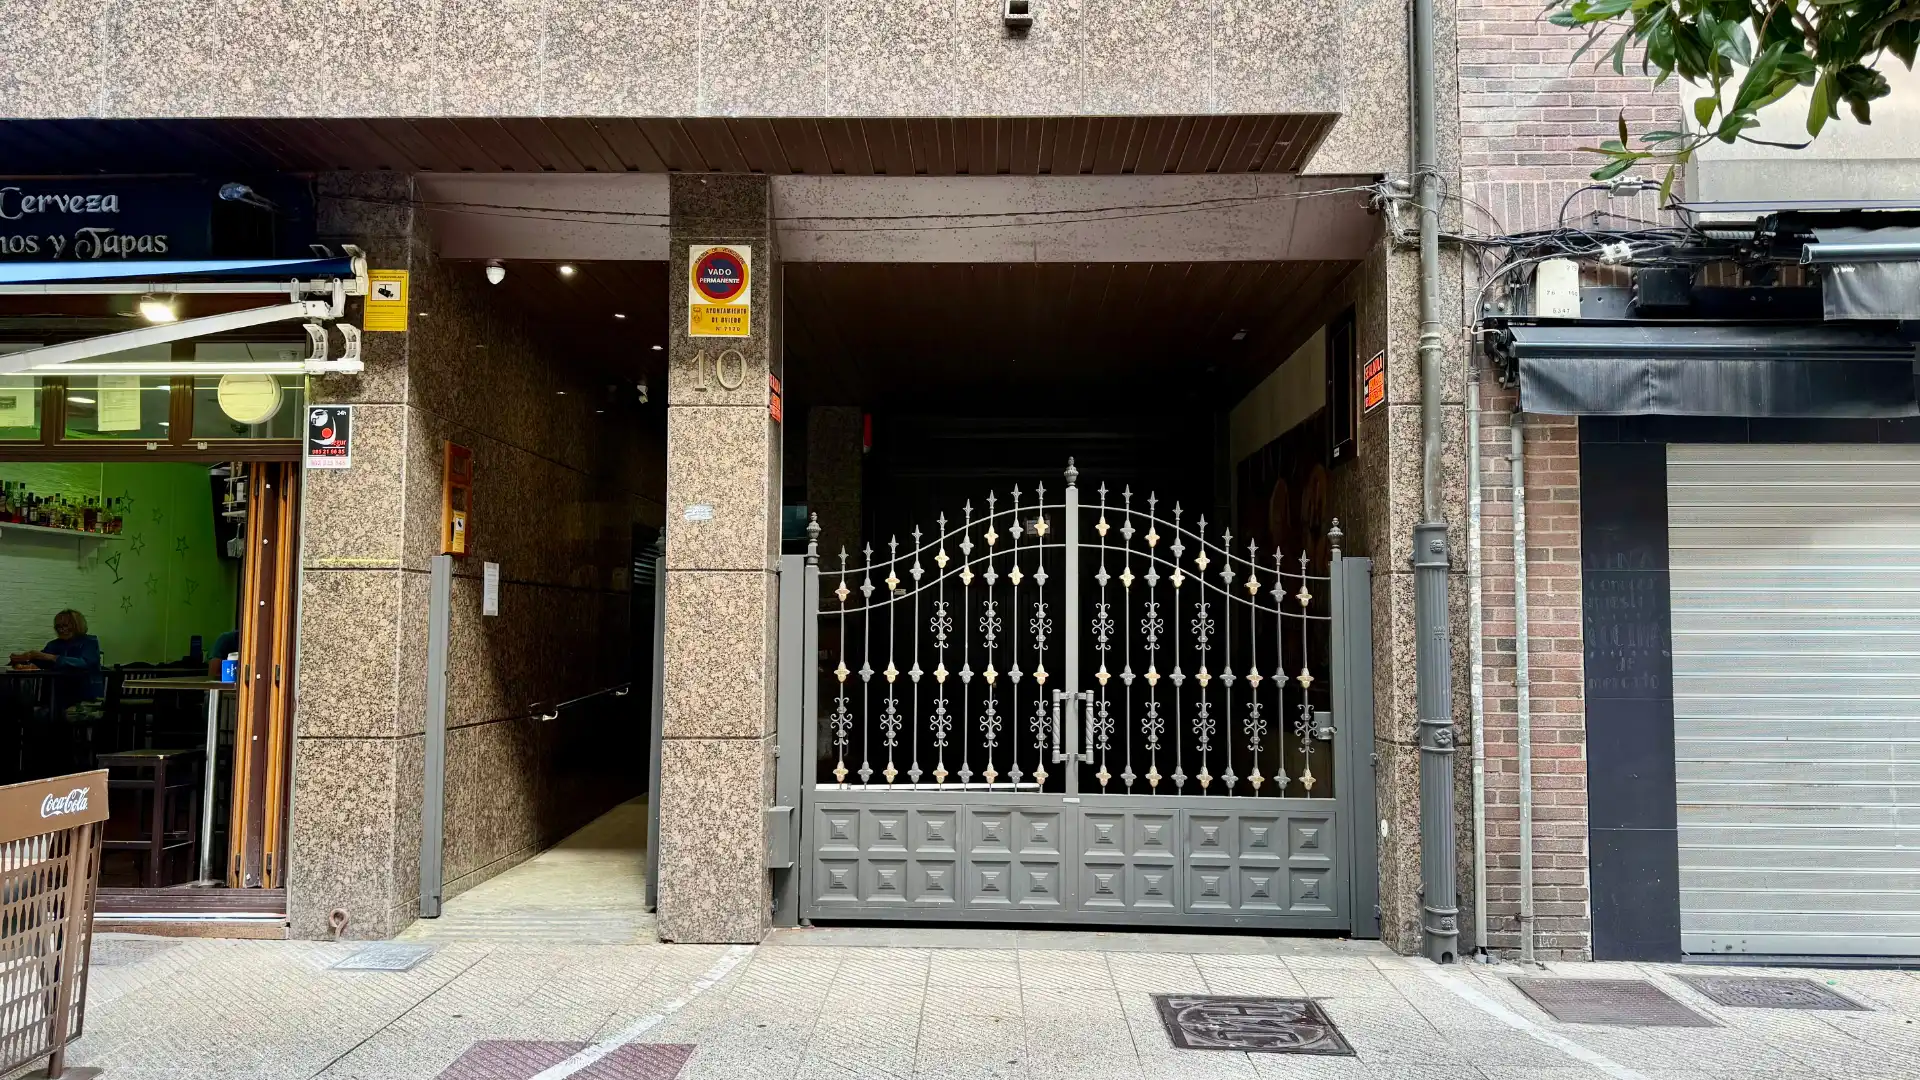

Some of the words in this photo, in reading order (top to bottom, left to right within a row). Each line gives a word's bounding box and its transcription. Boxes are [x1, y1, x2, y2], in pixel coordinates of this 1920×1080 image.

[0, 186, 120, 219] Cerveza
[46, 234, 67, 259] y
[74, 227, 168, 260] Tapas
[708, 268, 732, 276] VADO
[706, 307, 747, 315] AYUNTAMIENTO
[691, 349, 748, 392] 10
[40, 786, 91, 818] Coca-Cola
